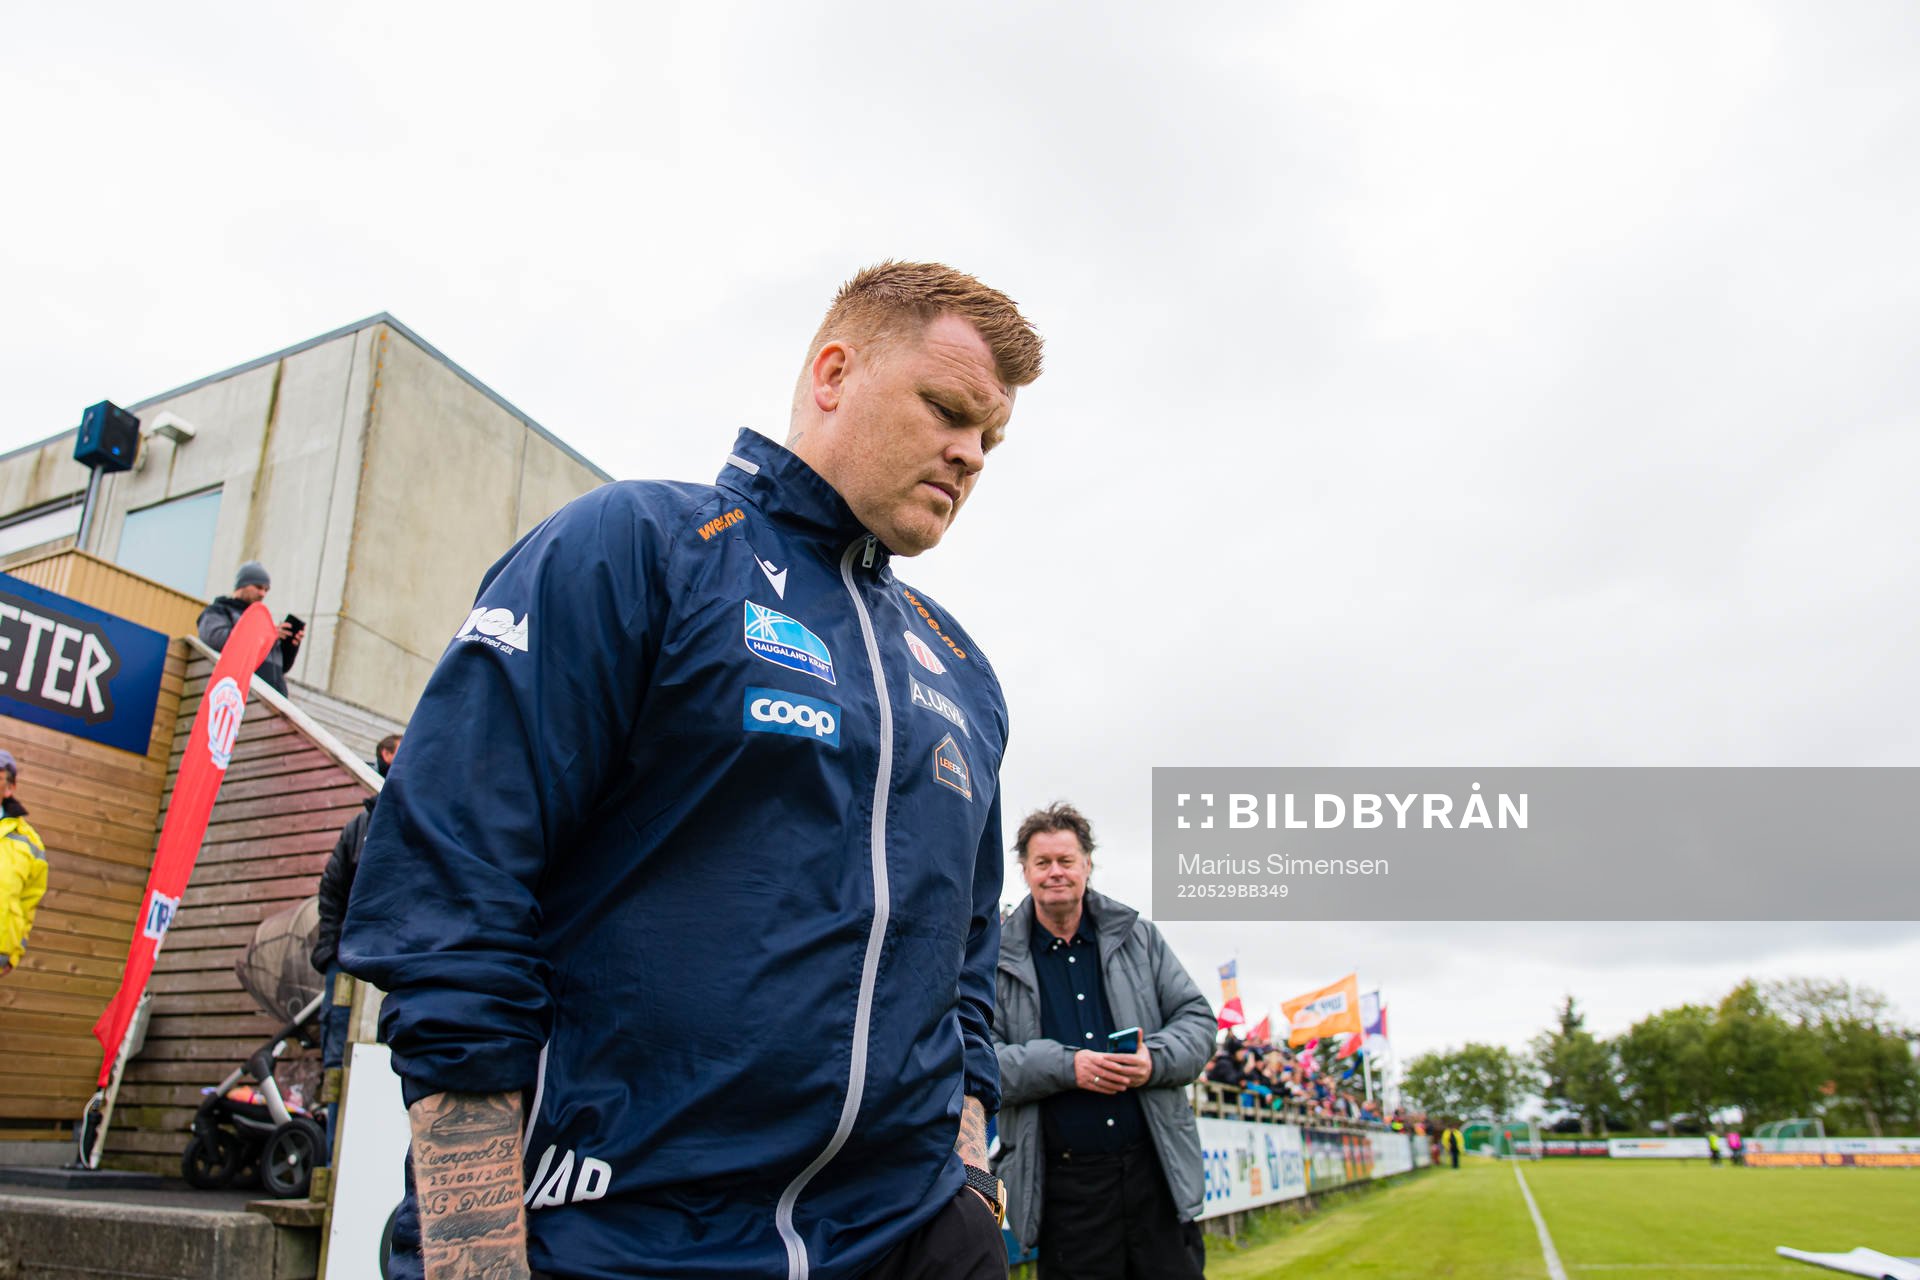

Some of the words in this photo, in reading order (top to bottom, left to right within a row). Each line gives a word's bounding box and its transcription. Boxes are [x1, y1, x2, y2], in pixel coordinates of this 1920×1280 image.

[903, 589, 967, 660] wee.no
[480, 636, 502, 648] med
[499, 644, 515, 656] stil
[753, 641, 808, 662] HAUGALAND
[808, 656, 831, 673] KRAFT
[750, 698, 836, 737] coop
[417, 1137, 498, 1169] Liverpool
